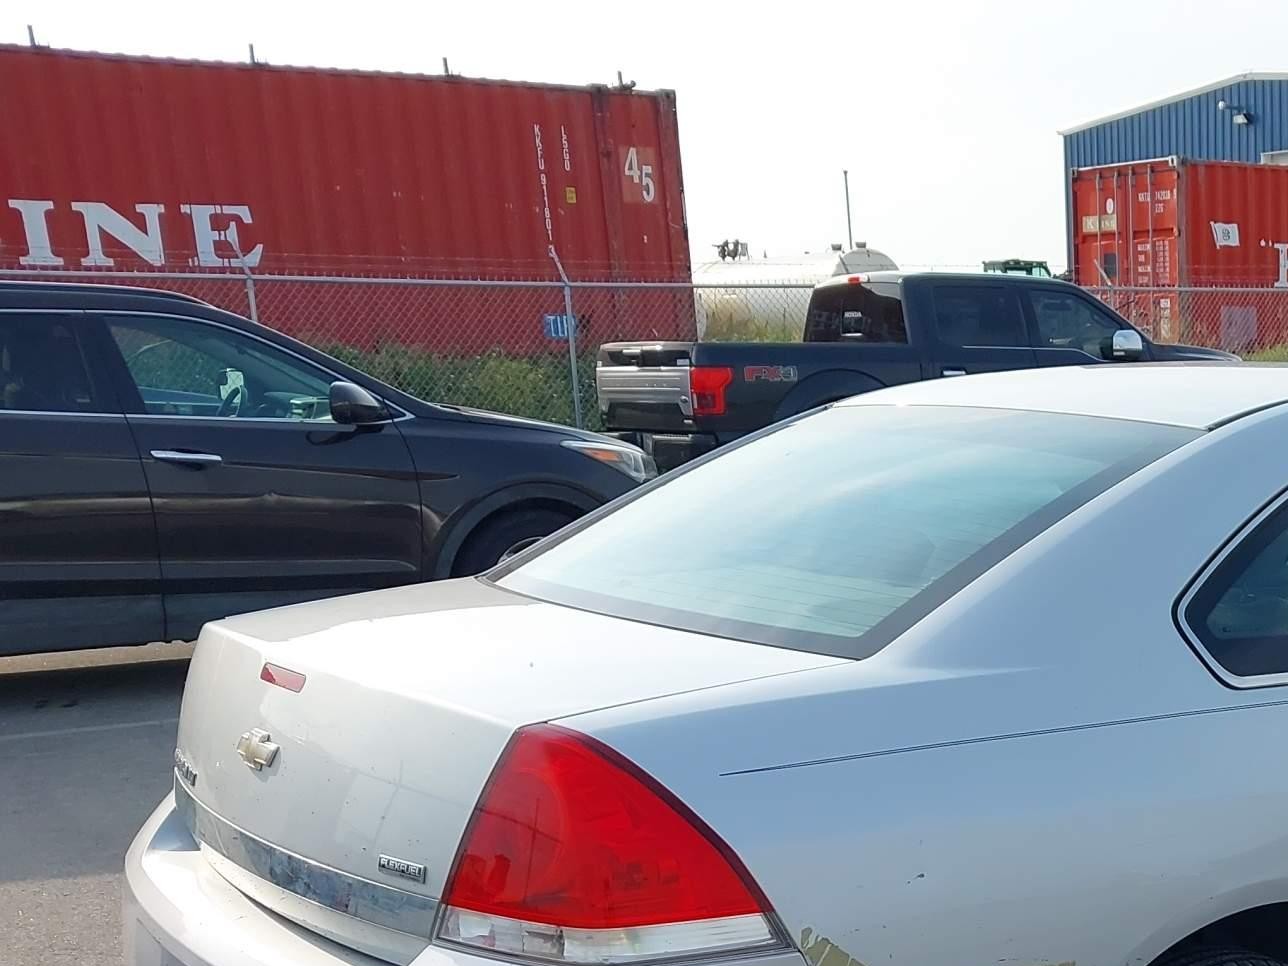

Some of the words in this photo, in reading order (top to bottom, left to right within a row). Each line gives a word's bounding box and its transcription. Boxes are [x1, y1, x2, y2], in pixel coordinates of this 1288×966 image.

[624, 146, 655, 203] 45
[7, 198, 264, 268] INE
[744, 366, 798, 382] FX4
[380, 857, 422, 877] FLEXFUEL
